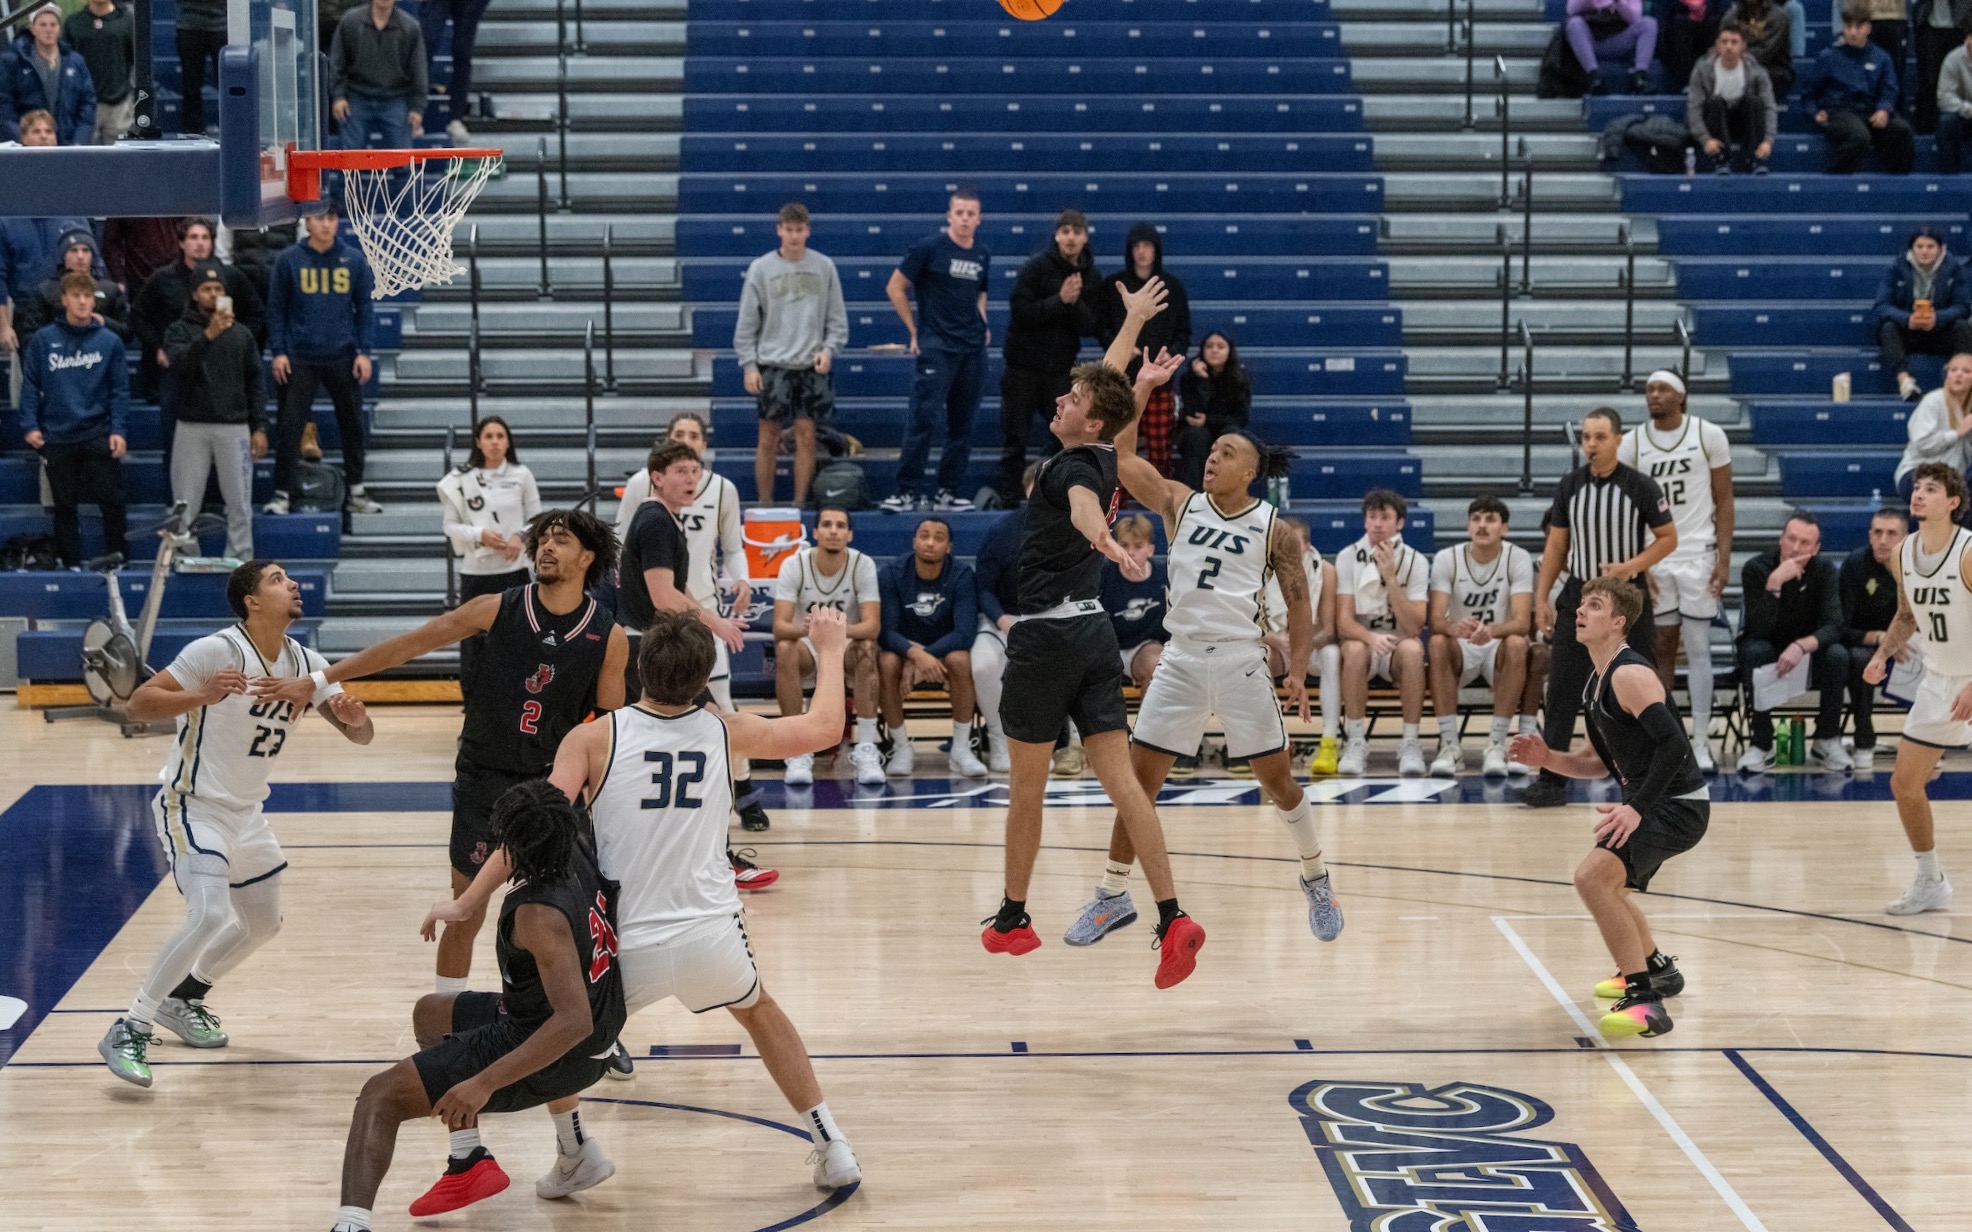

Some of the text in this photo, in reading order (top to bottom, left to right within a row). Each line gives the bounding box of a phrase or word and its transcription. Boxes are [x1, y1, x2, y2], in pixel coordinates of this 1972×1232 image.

[300, 267, 350, 294] UIS
[1651, 458, 1691, 477] UIS
[1663, 480, 1686, 505] 12
[1188, 525, 1249, 555] UIS
[1197, 556, 1222, 590] 2
[1463, 588, 1499, 607] UIS
[1913, 587, 1951, 605] UIS
[1928, 611, 1949, 642] 10
[519, 700, 542, 735] 2
[248, 724, 287, 758] 23
[640, 750, 707, 810] 32
